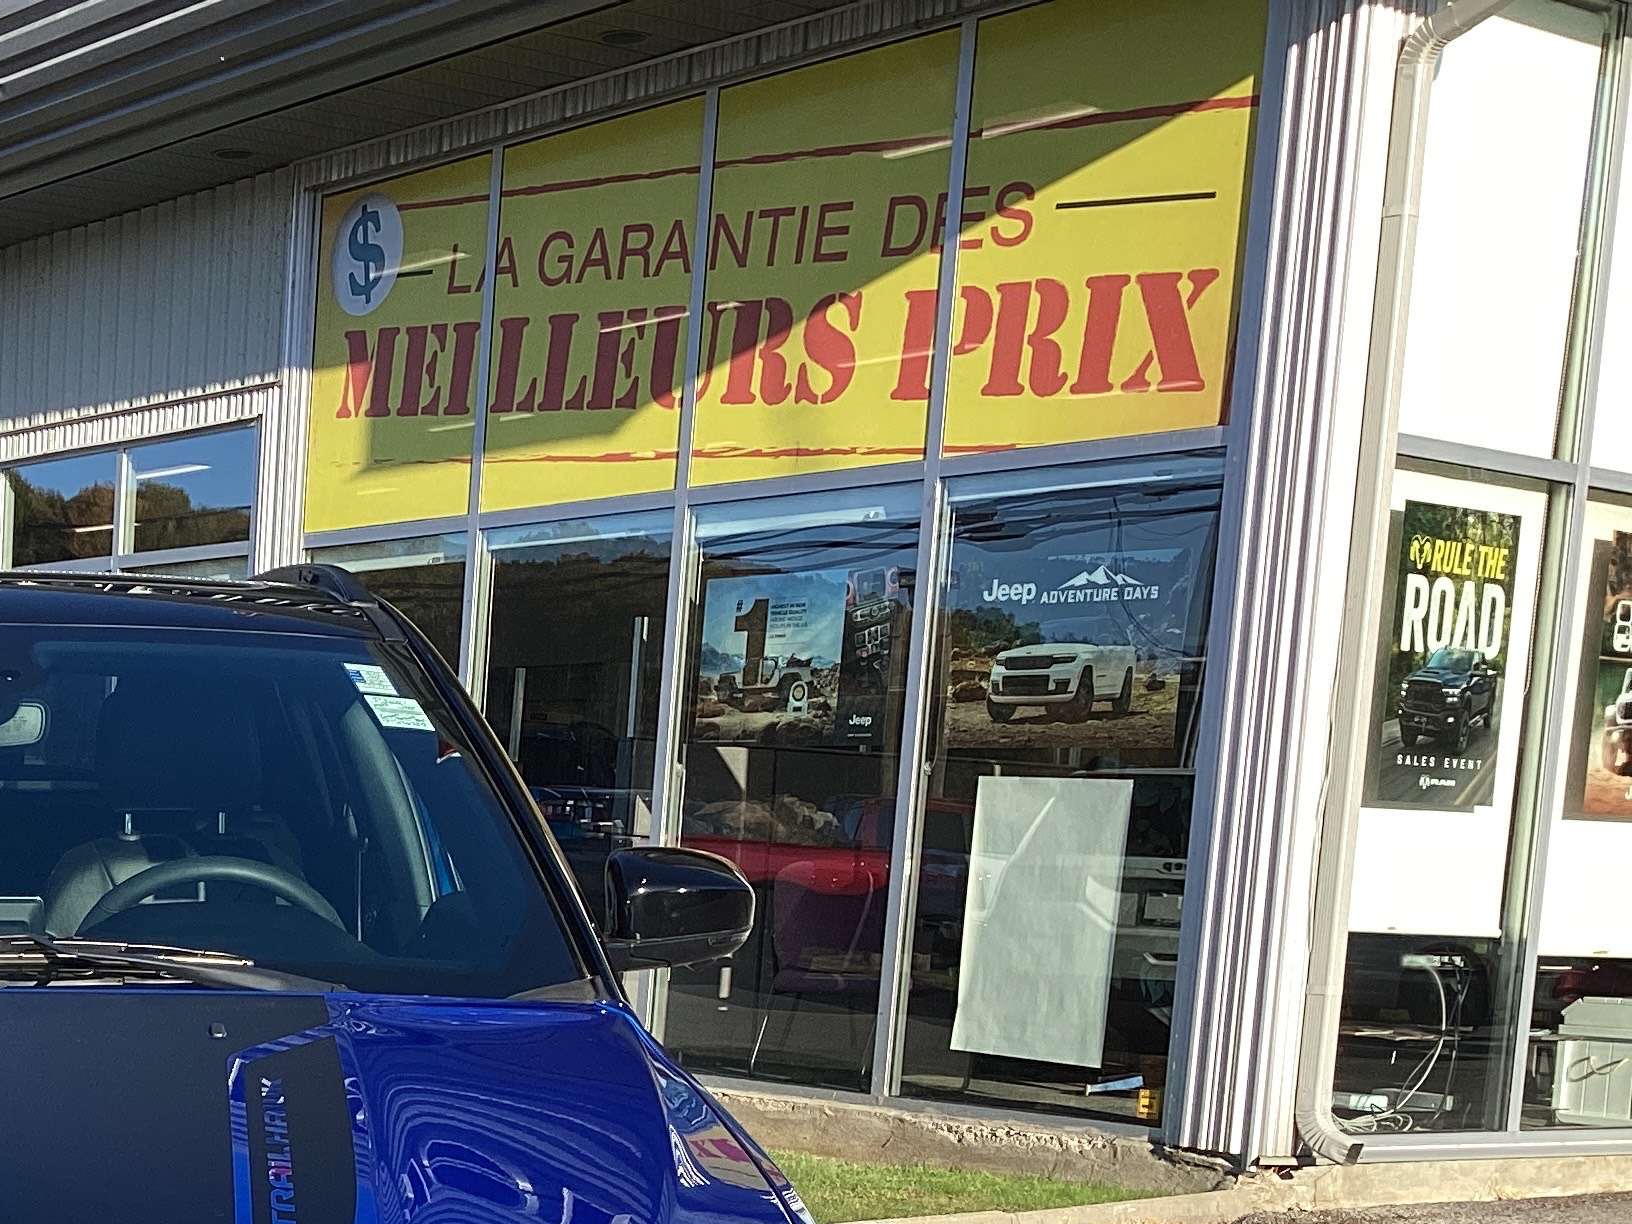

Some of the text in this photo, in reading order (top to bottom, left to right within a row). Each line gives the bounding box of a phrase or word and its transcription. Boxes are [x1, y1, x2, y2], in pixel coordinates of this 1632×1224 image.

[446, 182, 1037, 295] LA GARANTIE DES
[336, 268, 1220, 418] MEILLEURS PRIX
[1431, 538, 1509, 580] RULE THE
[983, 579, 1160, 605] Jeep ADVENTURE DAYS
[1400, 573, 1506, 660] ROAD
[848, 714, 872, 727] Jeep
[1397, 754, 1483, 770] SALES EVENT
